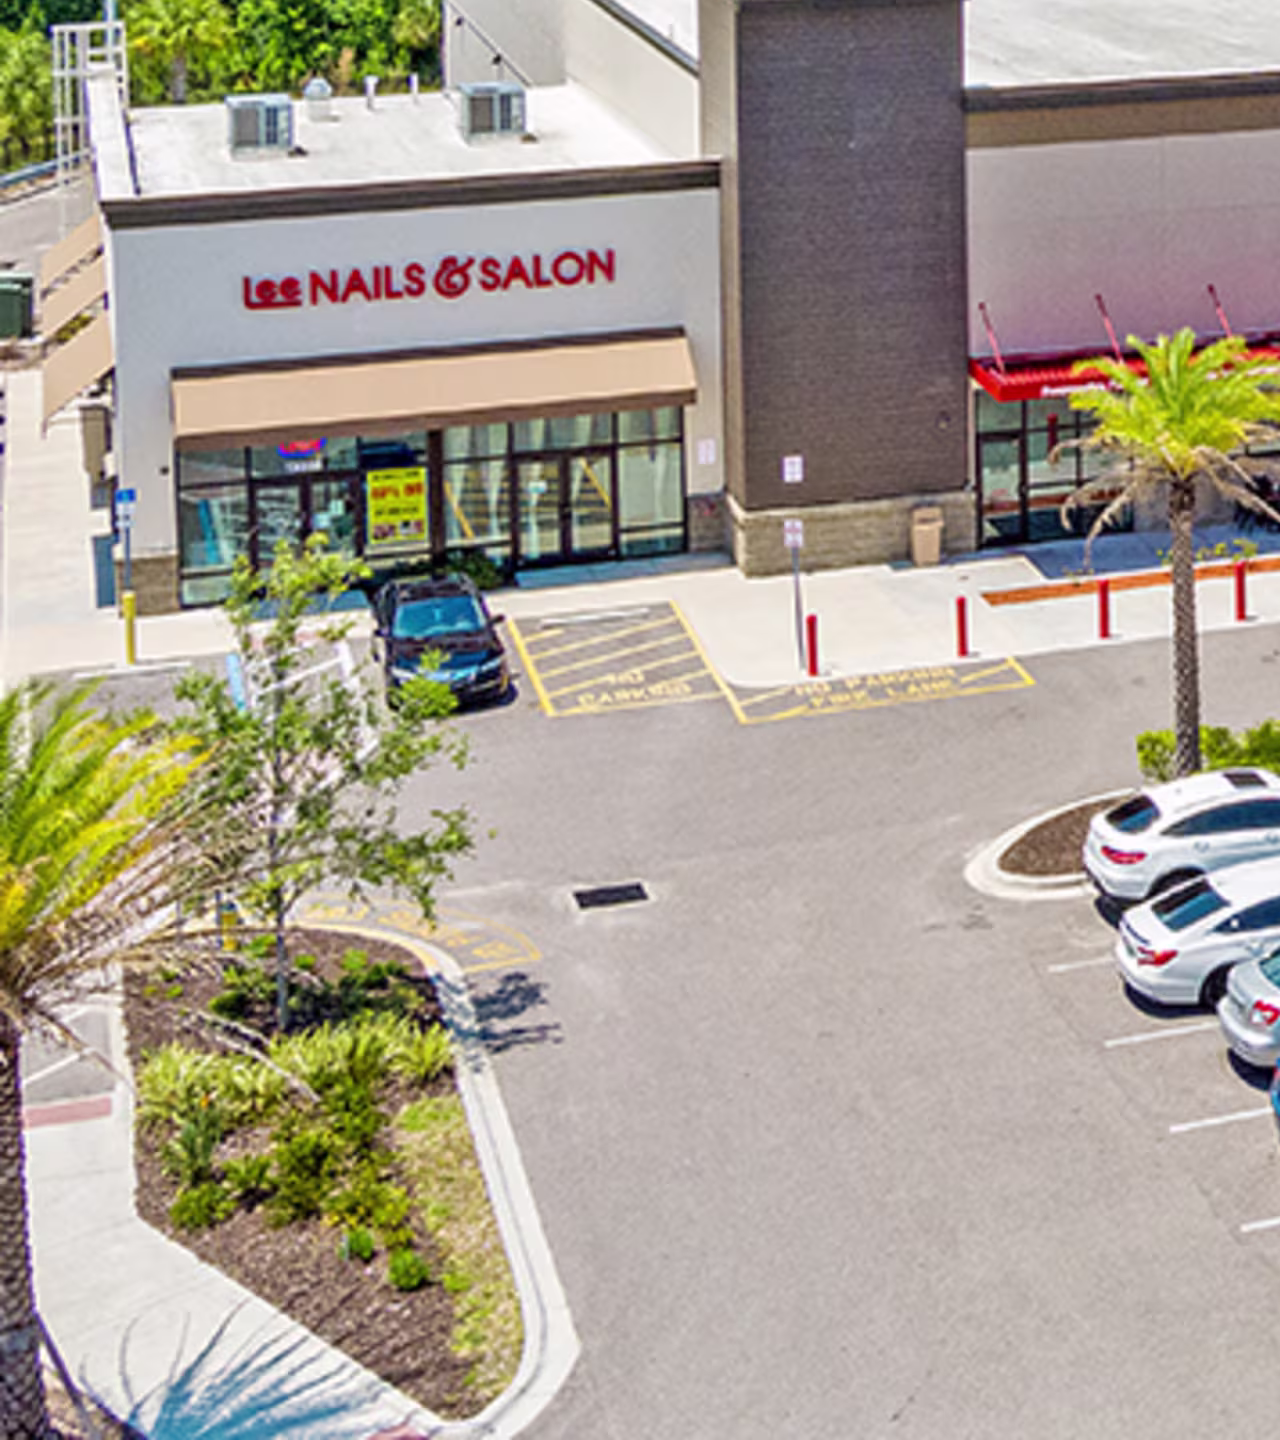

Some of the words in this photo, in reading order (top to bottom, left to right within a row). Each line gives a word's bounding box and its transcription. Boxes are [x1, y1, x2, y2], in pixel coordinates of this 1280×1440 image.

[243, 276, 303, 310] Lee
[309, 262, 427, 306] NAILS
[432, 255, 475, 299] &
[478, 248, 616, 292] SALON
